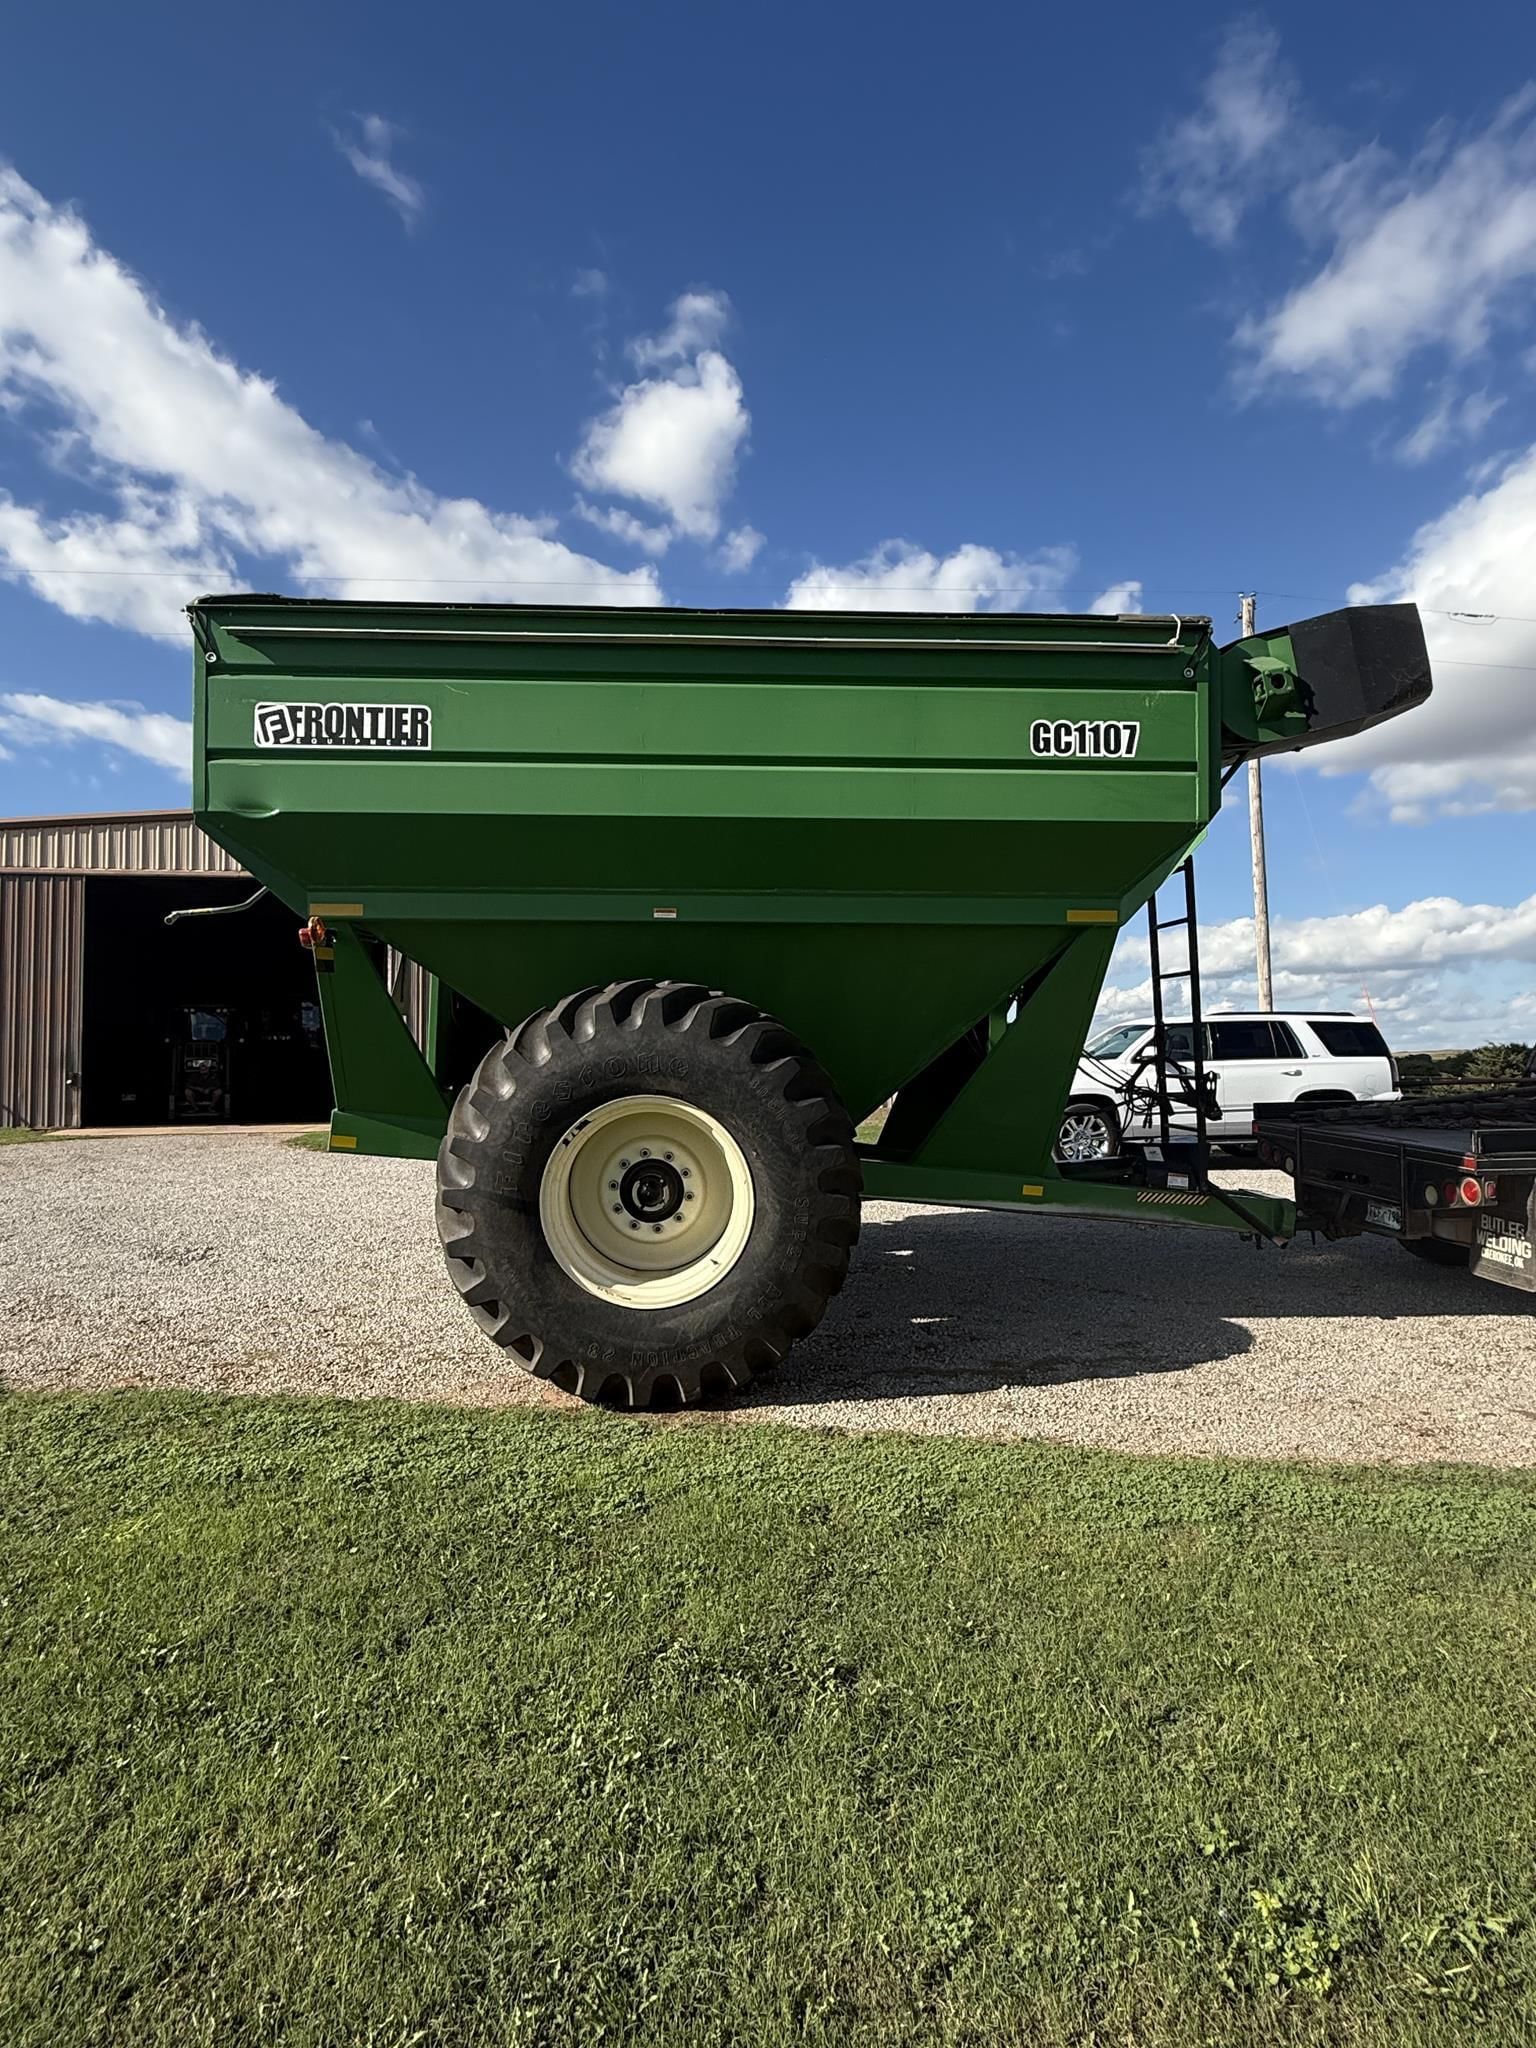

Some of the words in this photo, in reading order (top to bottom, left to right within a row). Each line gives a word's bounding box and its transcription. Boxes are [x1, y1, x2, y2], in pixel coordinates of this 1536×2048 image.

[289, 705, 429, 741] FRONTIER
[1032, 721, 1138, 755] GC1107
[296, 738, 422, 746] EQUIPMENT
[496, 1053, 689, 1194] Firestone
[1481, 1214, 1525, 1239] BUTLER
[1476, 1228, 1532, 1259] WELDING
[1514, 1256, 1524, 1269] OK
[587, 1342, 616, 1361] 23
[631, 1325, 742, 1367] TRACTION
